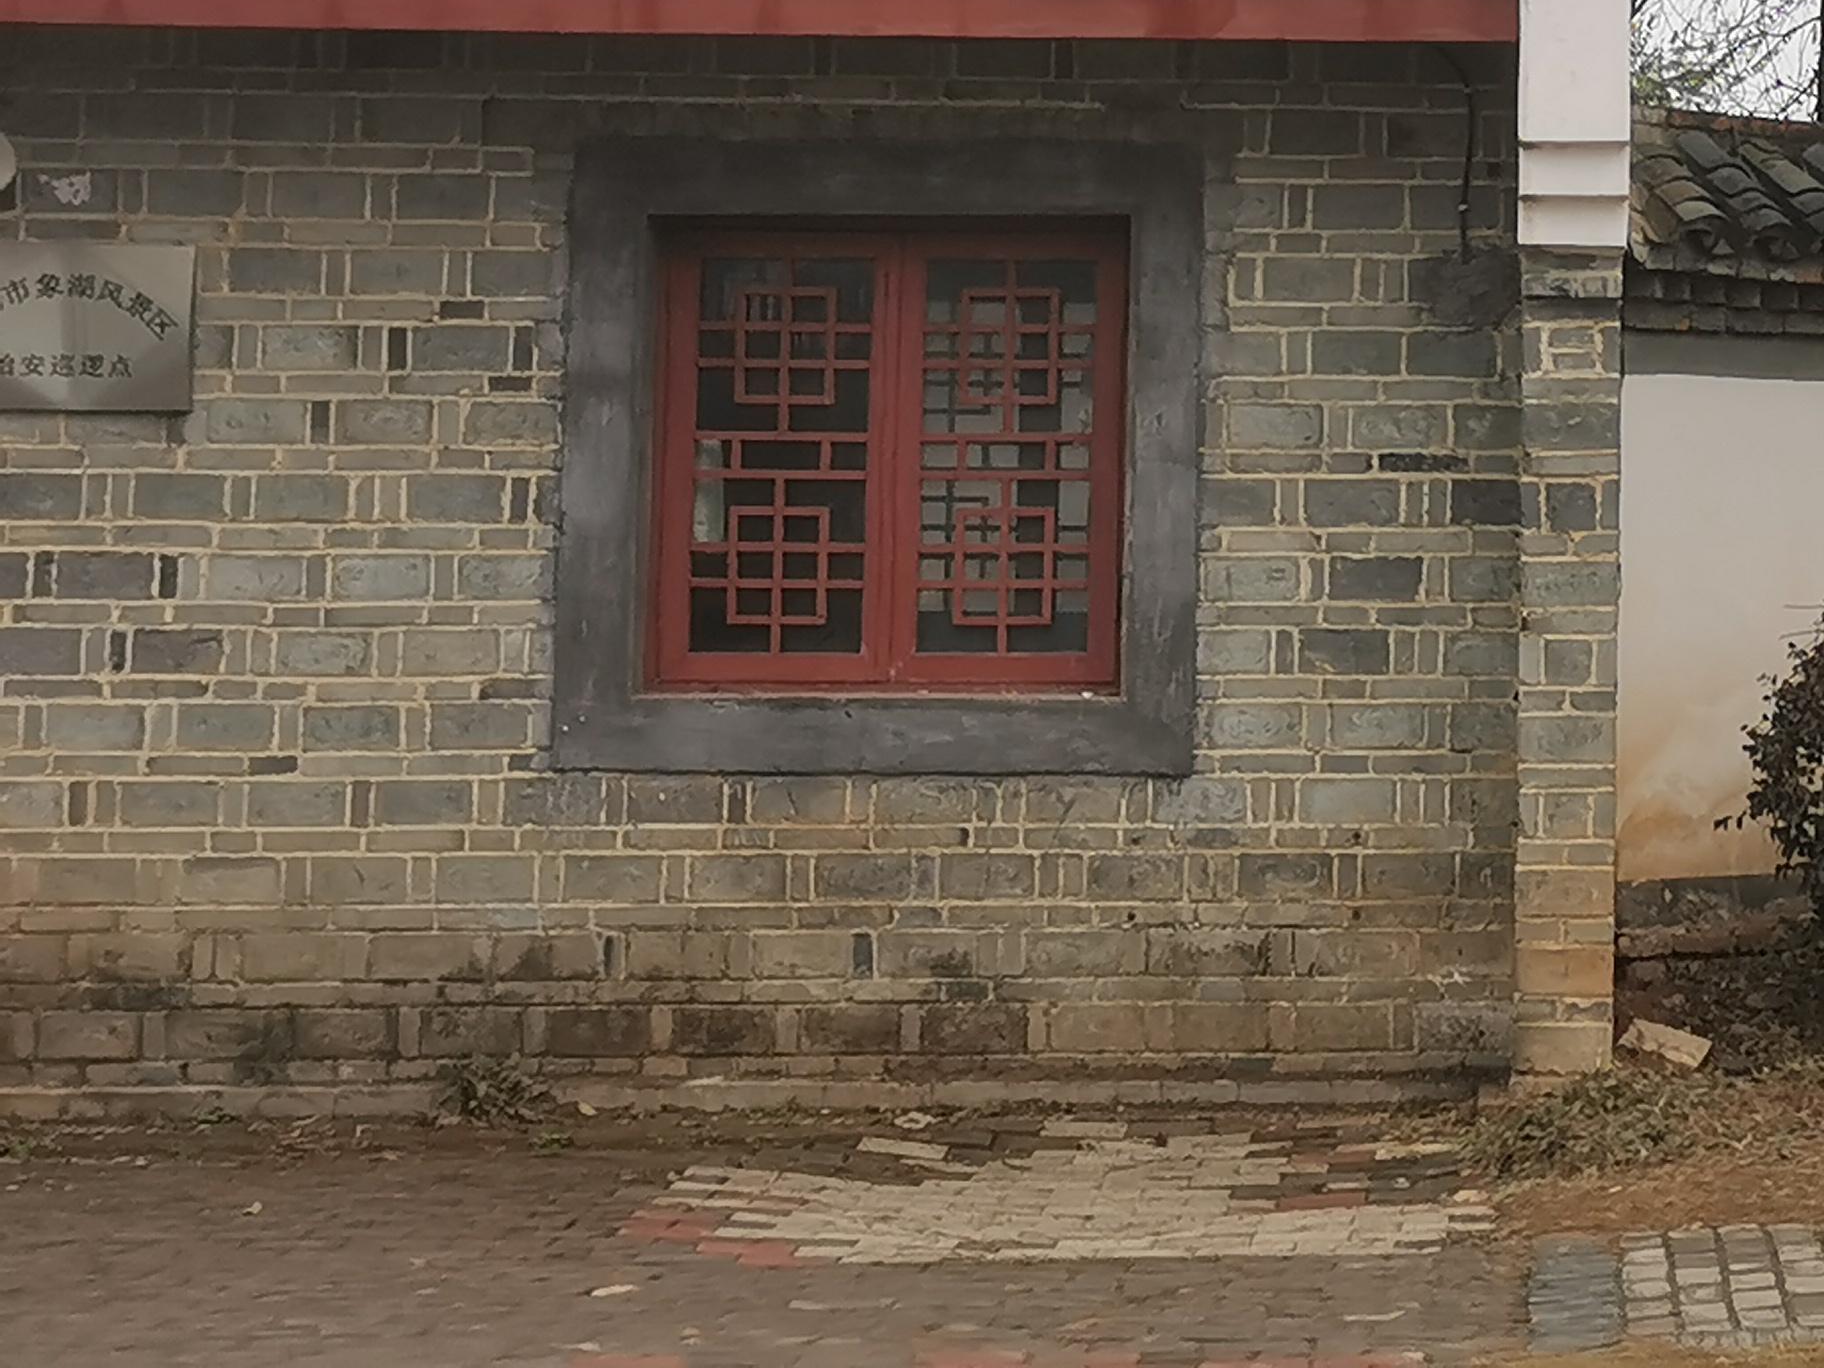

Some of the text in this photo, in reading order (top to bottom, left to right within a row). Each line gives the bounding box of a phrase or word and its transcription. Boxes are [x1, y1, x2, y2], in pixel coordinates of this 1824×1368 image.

[0, 272, 179, 341] 市象湖风景区
